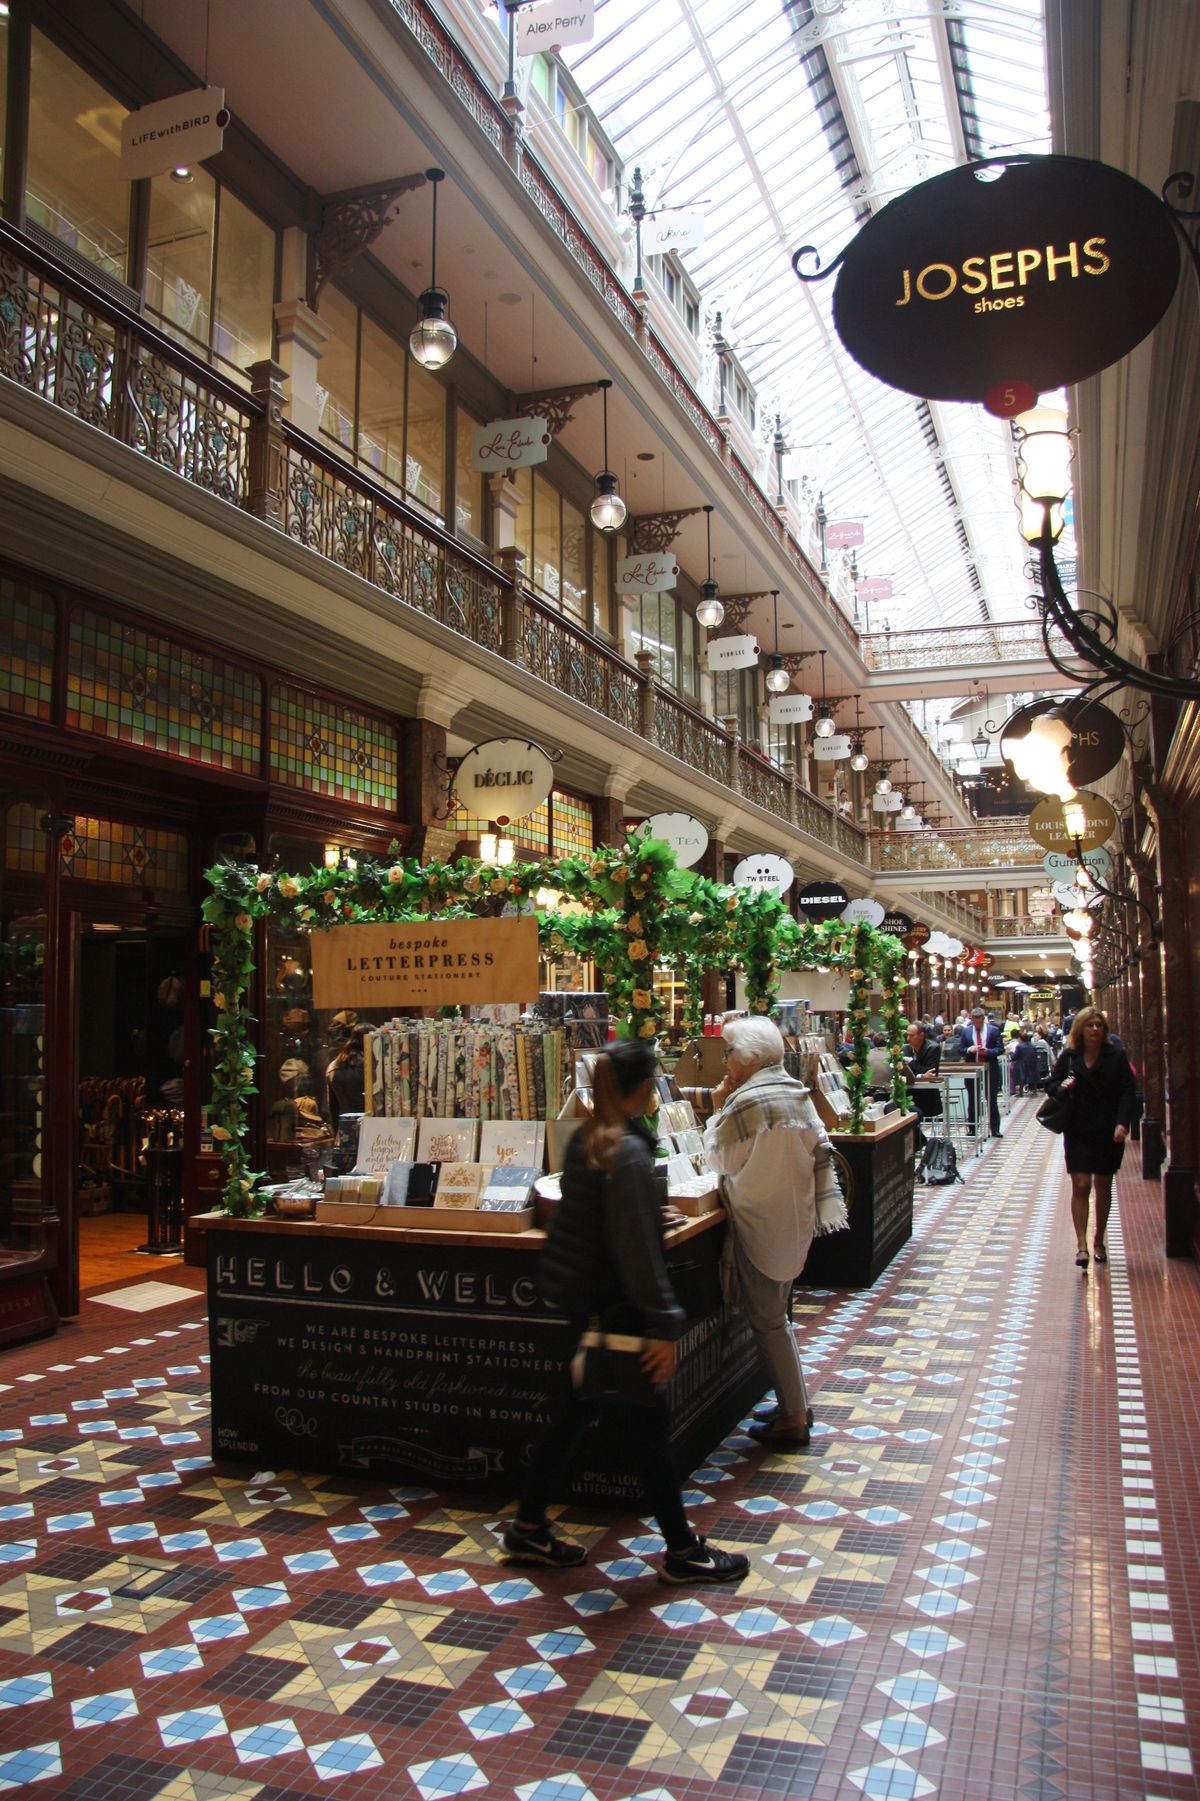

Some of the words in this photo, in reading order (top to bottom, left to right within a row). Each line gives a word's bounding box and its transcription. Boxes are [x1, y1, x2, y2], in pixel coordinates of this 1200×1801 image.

[526, 20, 553, 36] Alex
[555, 13, 587, 31] Perry
[131, 114, 211, 147] LIFEwithBIRD
[895, 236, 1112, 307] JOSEPHS
[974, 295, 1026, 314] shoes
[1003, 388, 1016, 407] 5
[474, 767, 534, 789] DÉCLIC
[1035, 820, 1064, 831] LOUIS
[1049, 830, 1096, 841] LEAER
[800, 896, 846, 905] DIESEL
[880, 925, 908, 933] SHINES
[884, 918, 904, 927] SHOE
[389, 936, 448, 951] bespoke
[347, 952, 496, 971] LETTERPRESS
[361, 974, 408, 982] COUTURE
[414, 972, 481, 980] STATIONERY
[216, 1255, 354, 1294] HELLO
[375, 1267, 397, 1297] &
[416, 1269, 560, 1309] WELC
[306, 1323, 325, 1336] WE
[331, 1326, 357, 1339] ARE
[363, 1329, 428, 1345] BESPOKE
[434, 1335, 536, 1354] LETTERPRESS
[277, 1336, 295, 1348] WE
[302, 1339, 352, 1354] DESIGN
[374, 1346, 460, 1363] HANDPRINT
[466, 1354, 565, 1373] STATIONERY
[254, 1383, 291, 1399] FROM
[297, 1387, 325, 1402] OUR
[331, 1392, 399, 1410] COUNTRY
[404, 1400, 460, 1416] STUDIO
[466, 1408, 483, 1418] IN
[217, 1428, 239, 1440] HOW
